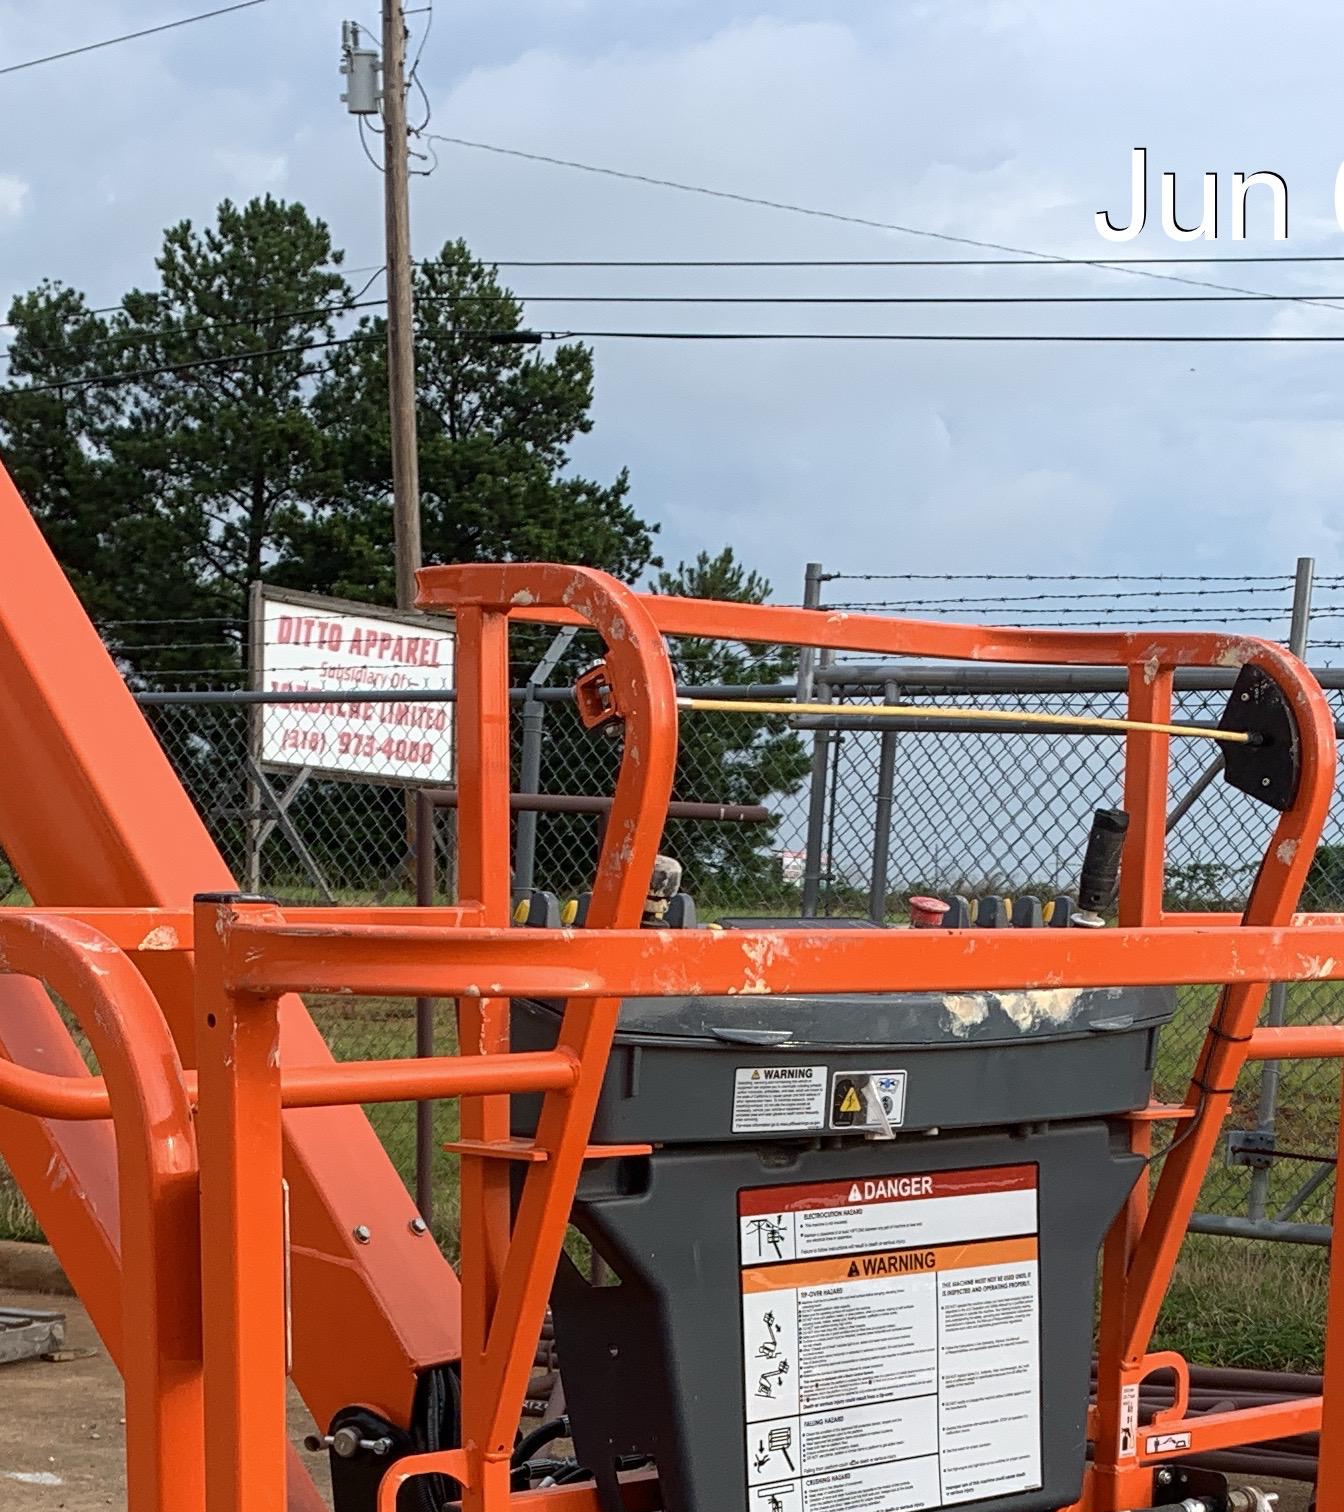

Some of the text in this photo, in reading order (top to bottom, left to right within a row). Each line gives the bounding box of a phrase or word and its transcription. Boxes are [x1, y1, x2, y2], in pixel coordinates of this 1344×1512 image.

[277, 614, 440, 669] DITTO APPAREL
[319, 660, 387, 689] Subsidiary
[763, 1068, 814, 1080] WARNING
[864, 1176, 933, 1201] DANGER
[863, 1251, 936, 1276] WARNING
